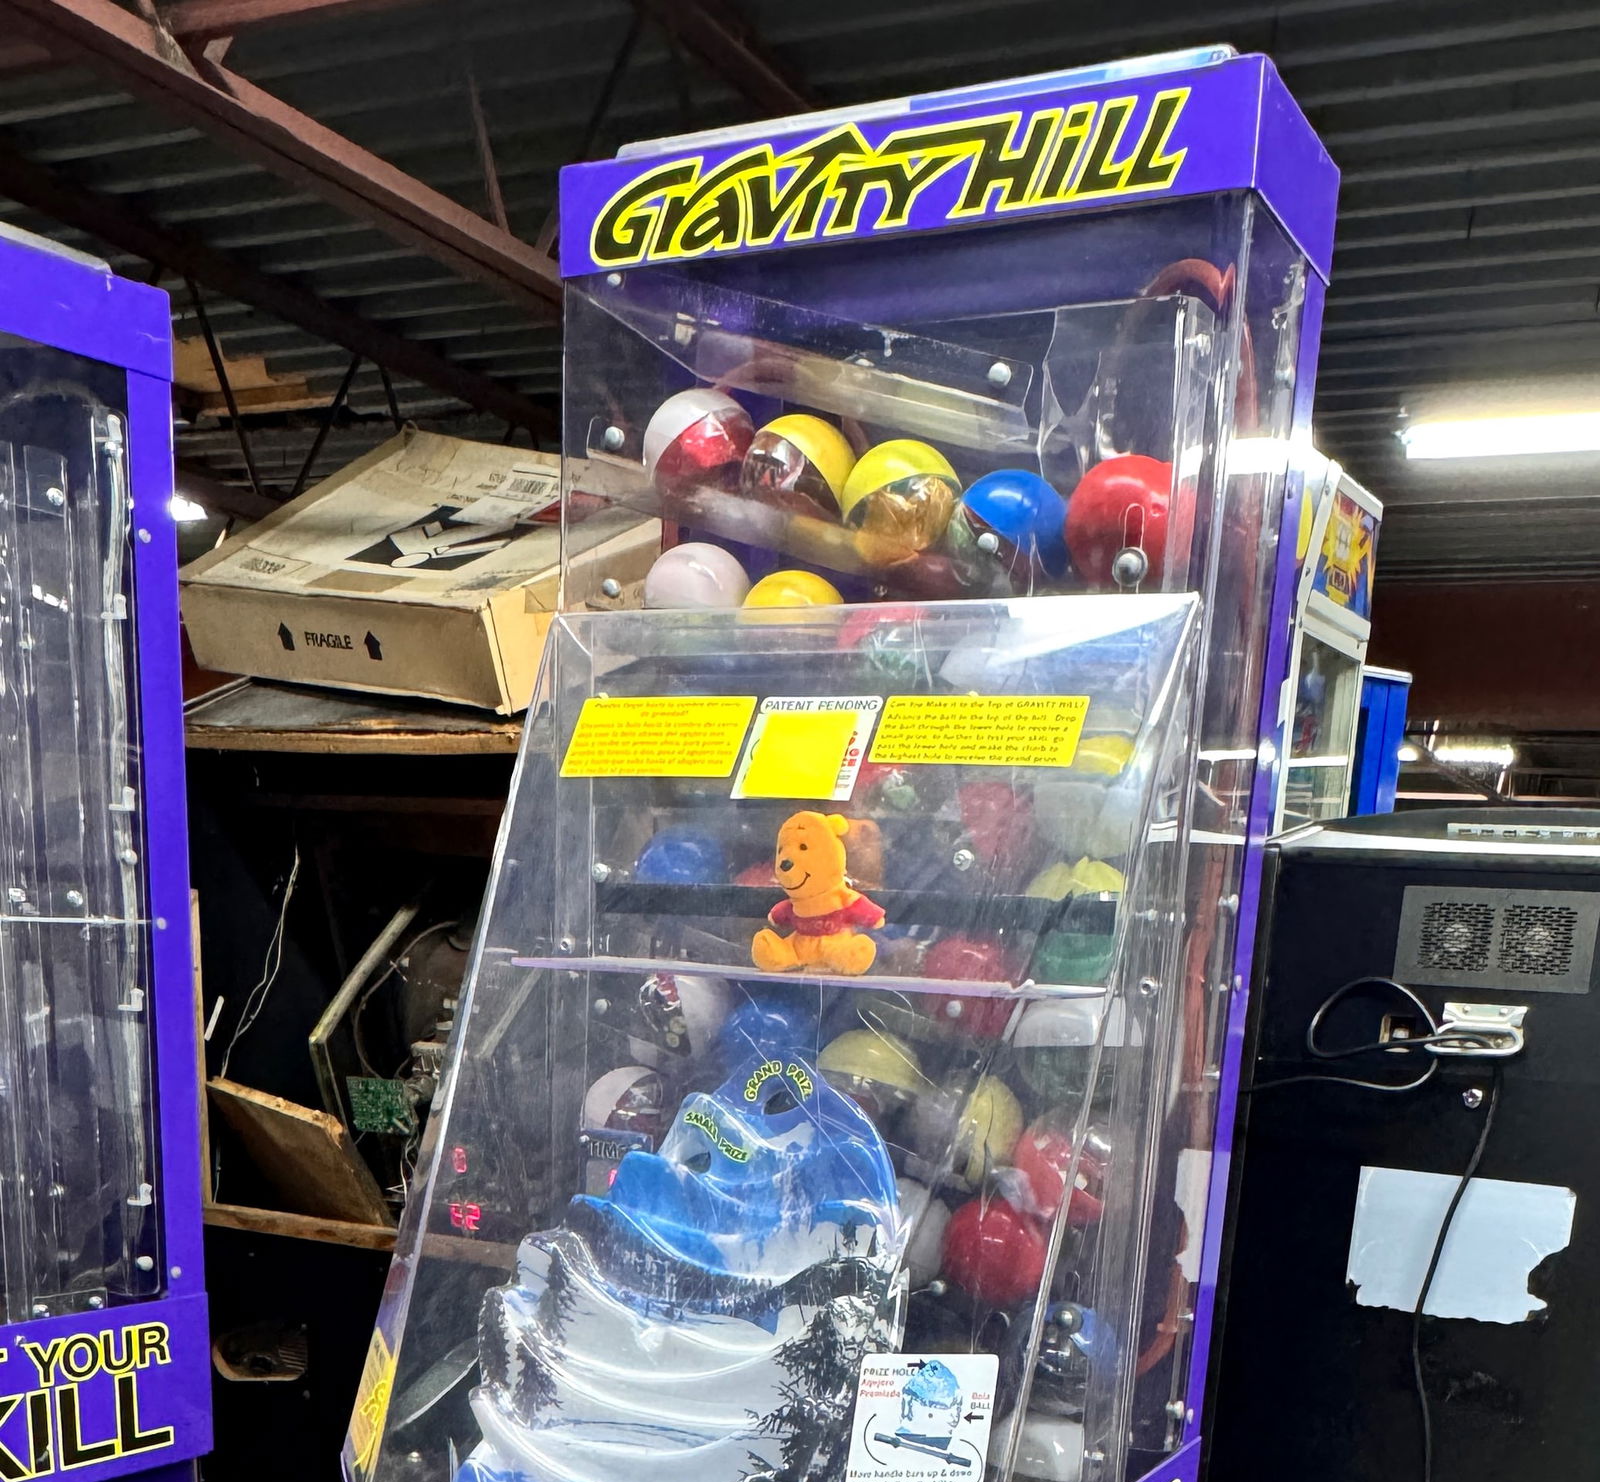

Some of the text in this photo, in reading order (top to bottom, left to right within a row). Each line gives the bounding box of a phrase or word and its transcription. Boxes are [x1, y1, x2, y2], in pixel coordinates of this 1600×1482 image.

[304, 631, 354, 650] FRAGILE
[765, 700, 878, 711] PATENT PENDING
[744, 1060, 813, 1102] GRAND PRIZ
[684, 1111, 749, 1163] SMALL PRIZE
[21, 1322, 172, 1387] YOUR
[863, 1368, 889, 1376] PRIZE
[970, 1401, 991, 1410] BALL
[850, 1470, 871, 1478] Move
[874, 1470, 903, 1478] handle
[926, 1470, 939, 1480] up
[940, 1469, 947, 1477] &
[949, 1469, 973, 1477] down
